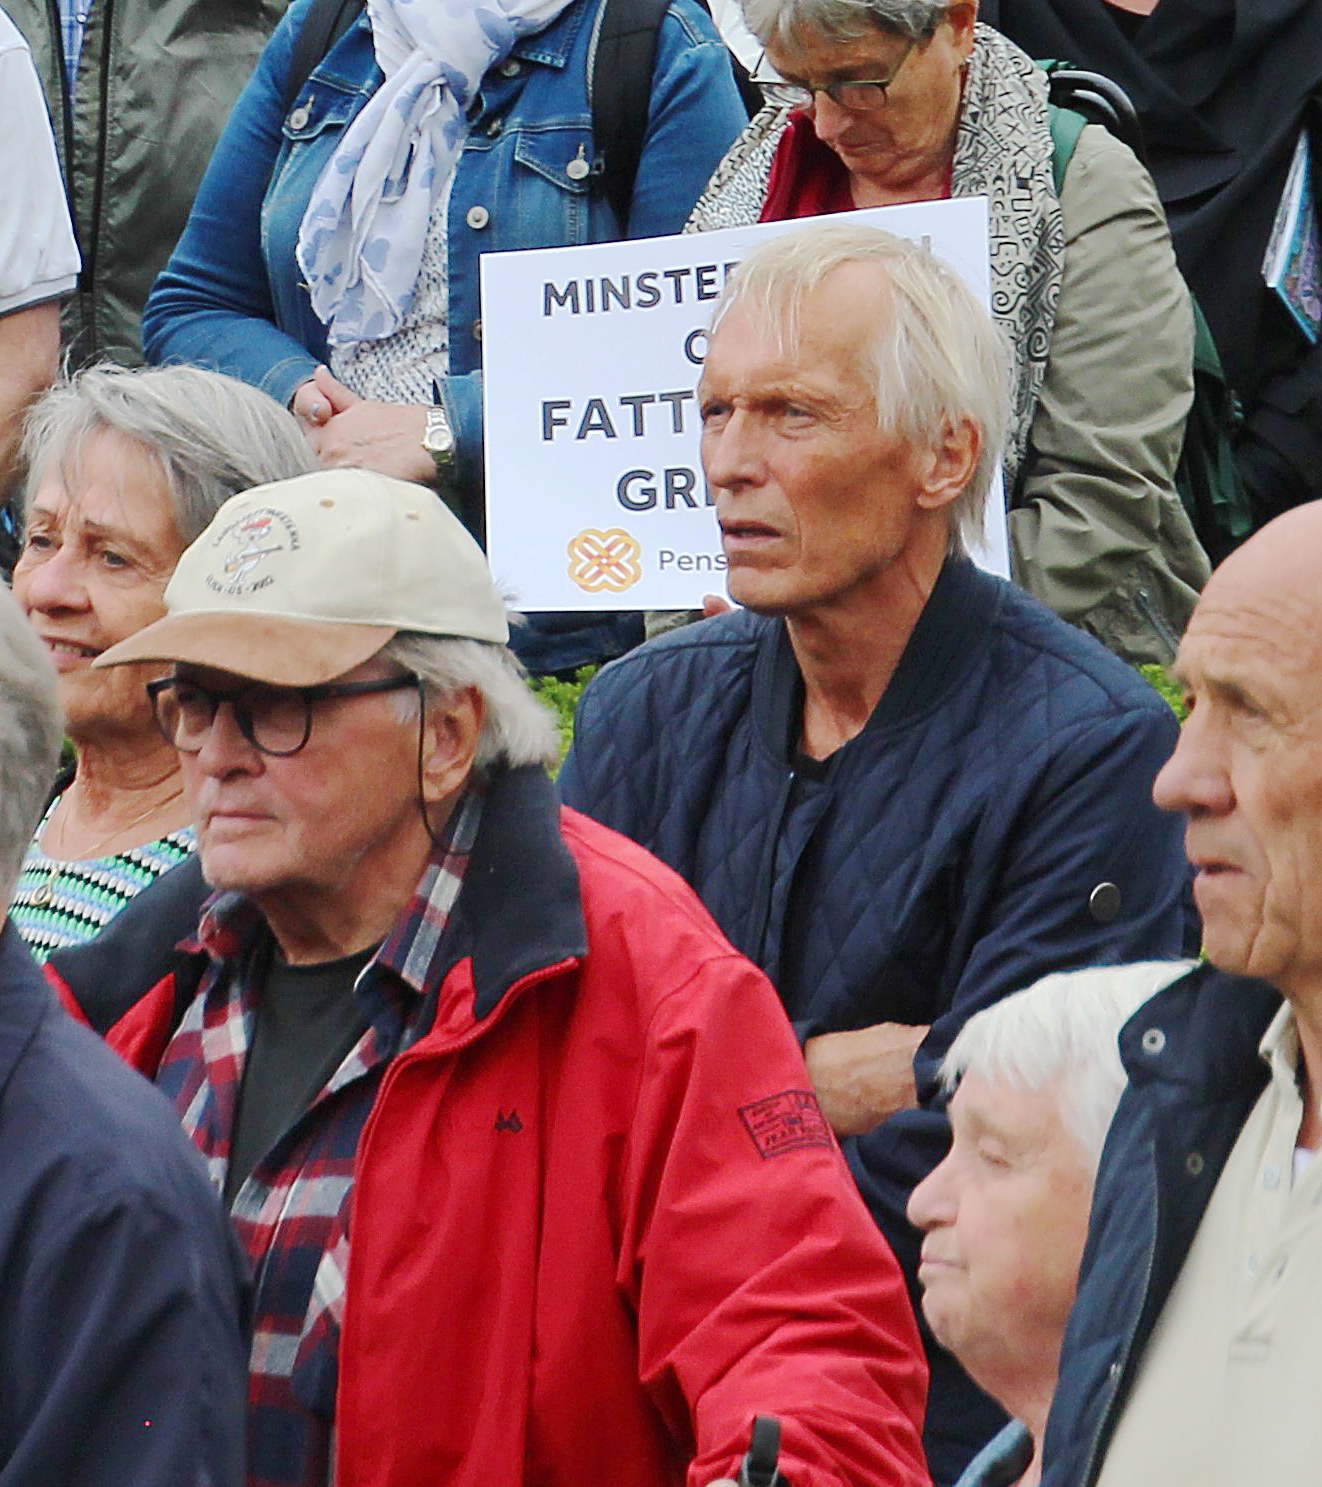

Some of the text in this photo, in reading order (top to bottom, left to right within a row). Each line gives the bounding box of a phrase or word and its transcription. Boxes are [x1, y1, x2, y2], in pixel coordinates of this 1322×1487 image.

[543, 261, 742, 317] MINSTE
[684, 328, 707, 366] O
[541, 389, 695, 442] FATT
[616, 467, 715, 512] GR
[659, 549, 728, 577] Pens
